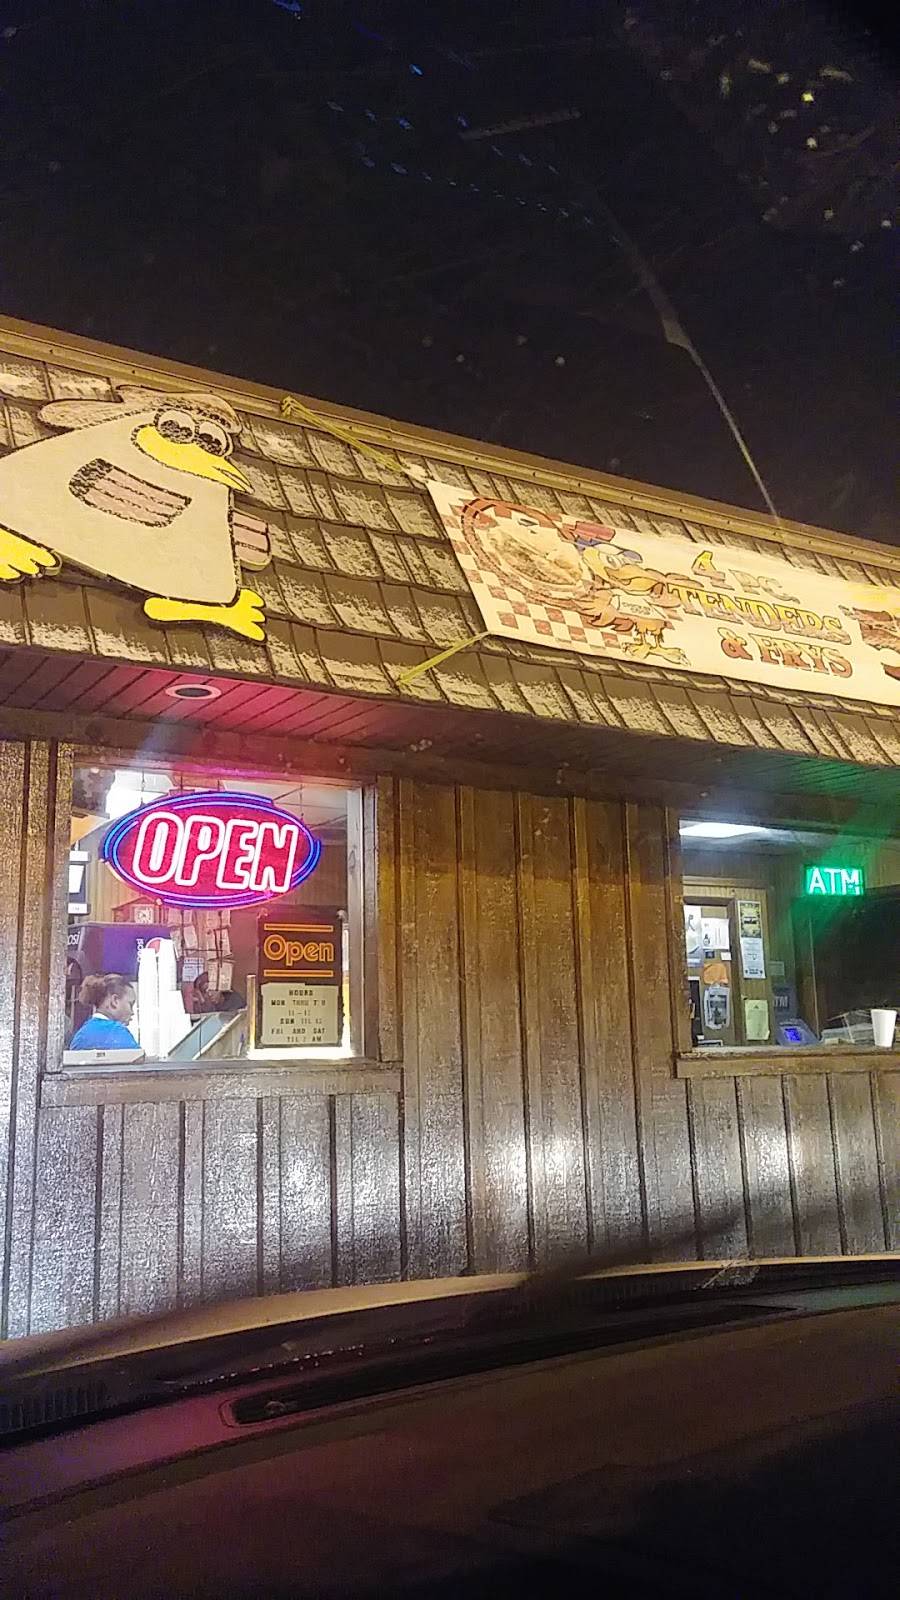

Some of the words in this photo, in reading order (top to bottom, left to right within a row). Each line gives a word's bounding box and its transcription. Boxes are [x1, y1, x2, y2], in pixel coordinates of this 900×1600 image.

[691, 550, 735, 591] 4
[717, 627, 753, 660] &
[748, 633, 853, 678] FRYS
[132, 811, 299, 893] OPEN
[808, 867, 861, 896] ATM
[264, 934, 334, 967] Open
